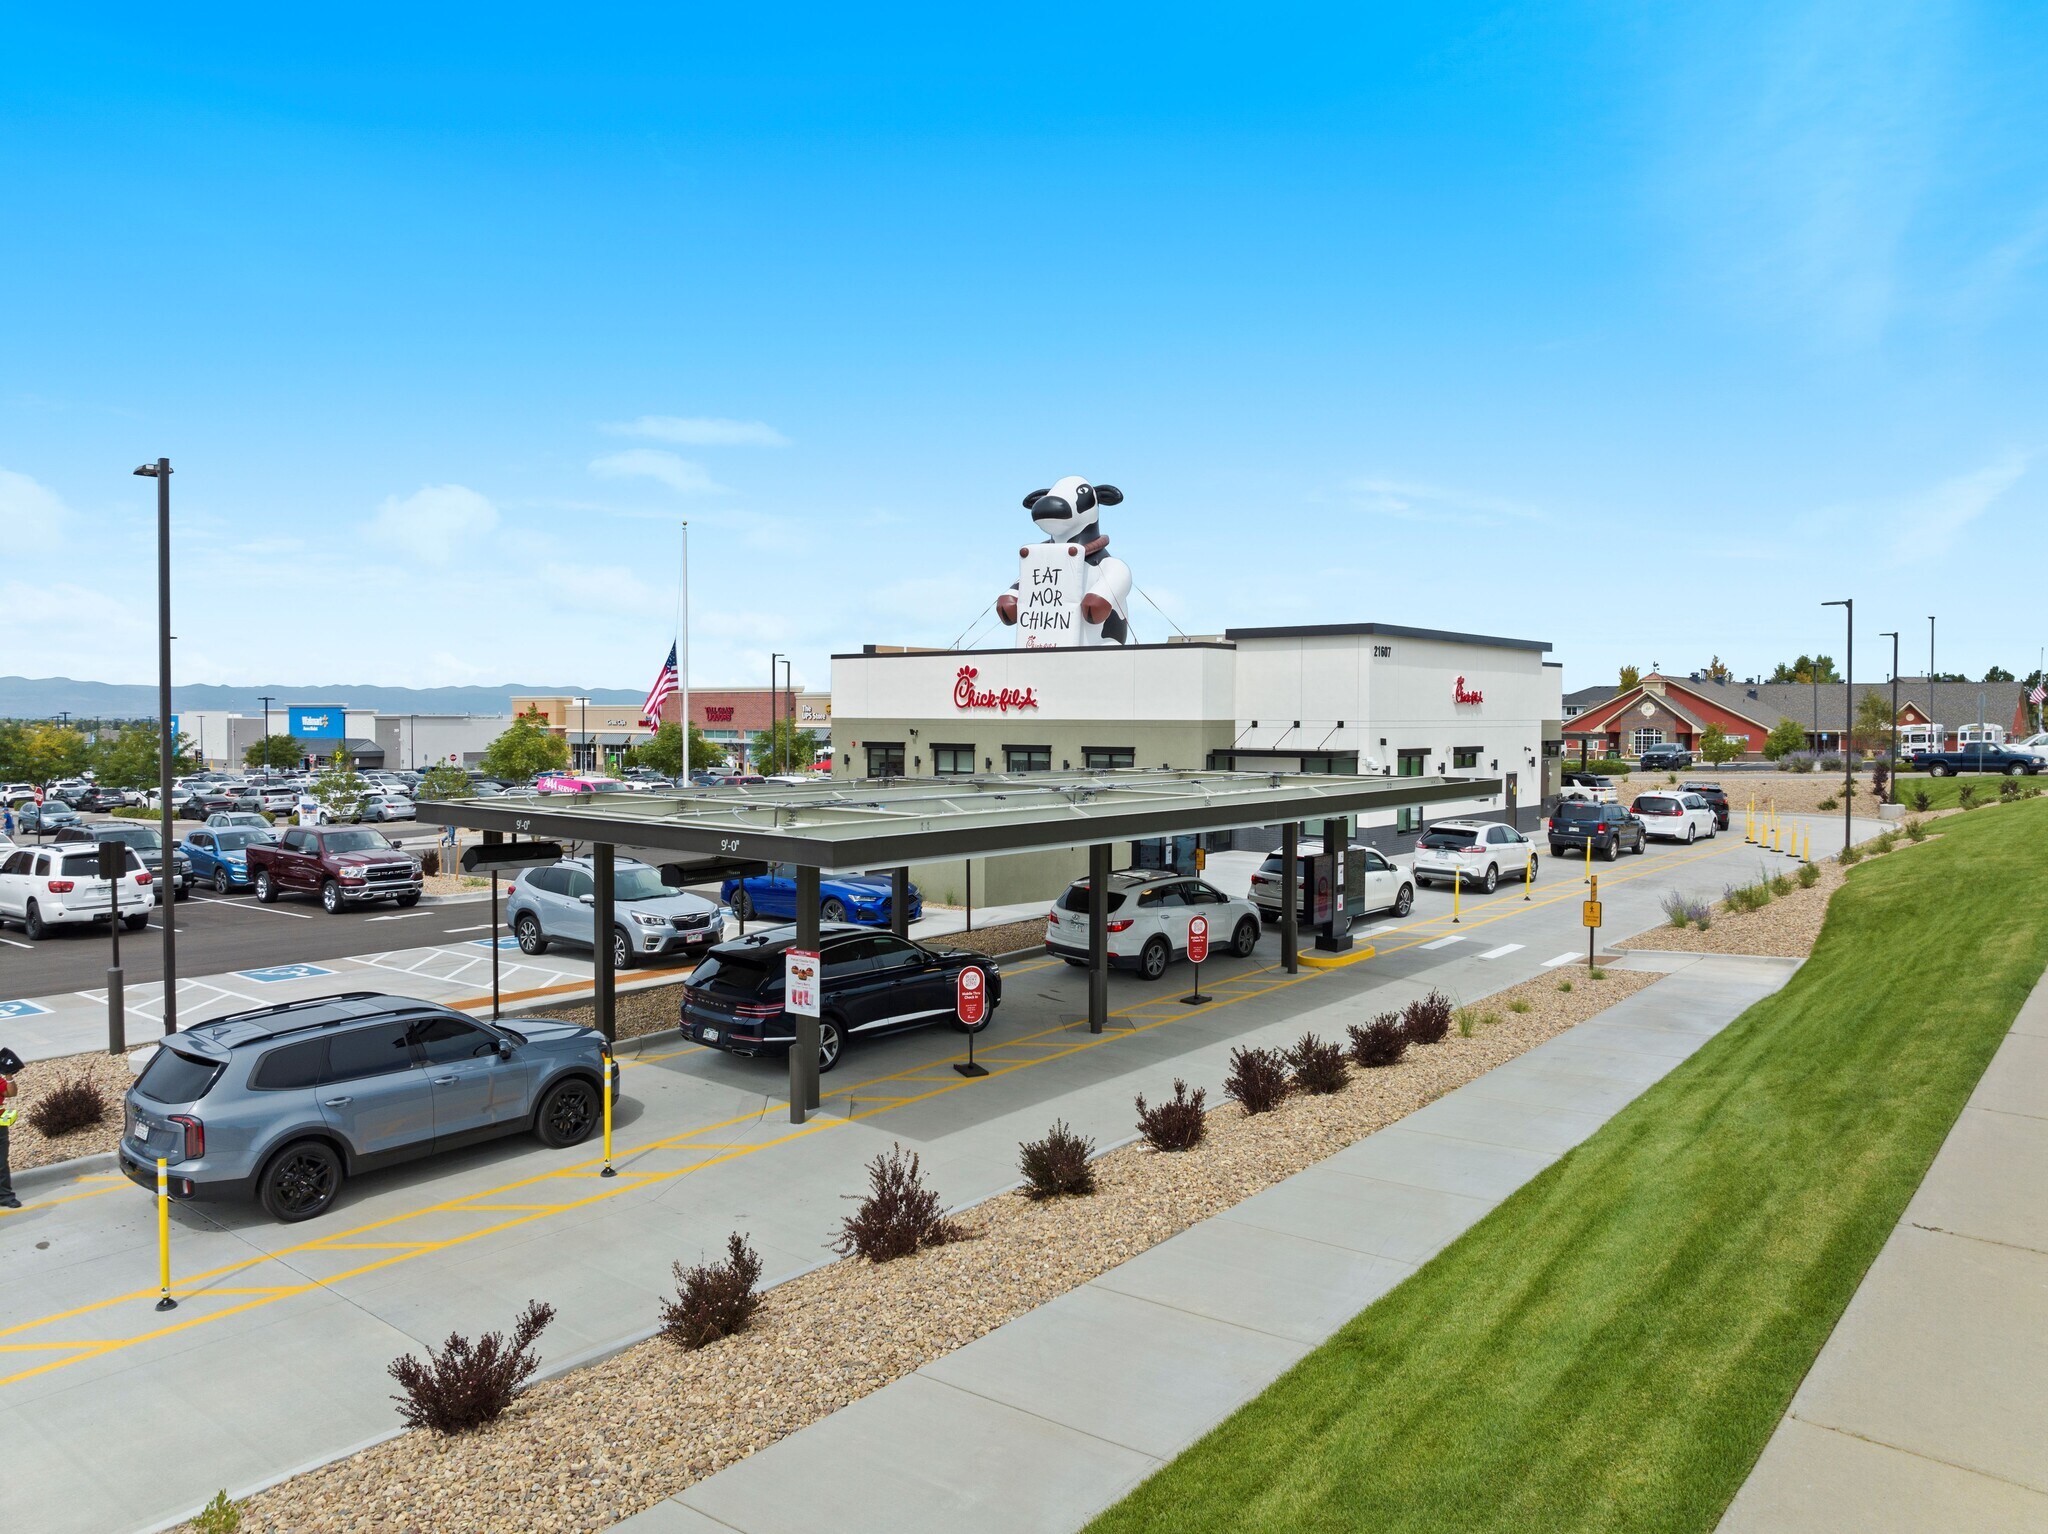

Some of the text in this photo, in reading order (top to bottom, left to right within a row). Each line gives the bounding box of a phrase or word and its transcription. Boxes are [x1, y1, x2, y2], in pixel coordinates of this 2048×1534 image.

[1032, 567, 1062, 585] EAT
[1029, 588, 1062, 607] MOR
[1020, 611, 1070, 630] CHIKIN
[1374, 646, 1391, 657] 21607
[954, 665, 1038, 711] Chick-fil-A
[802, 705, 812, 713] The
[543, 778, 557, 790] AAA
